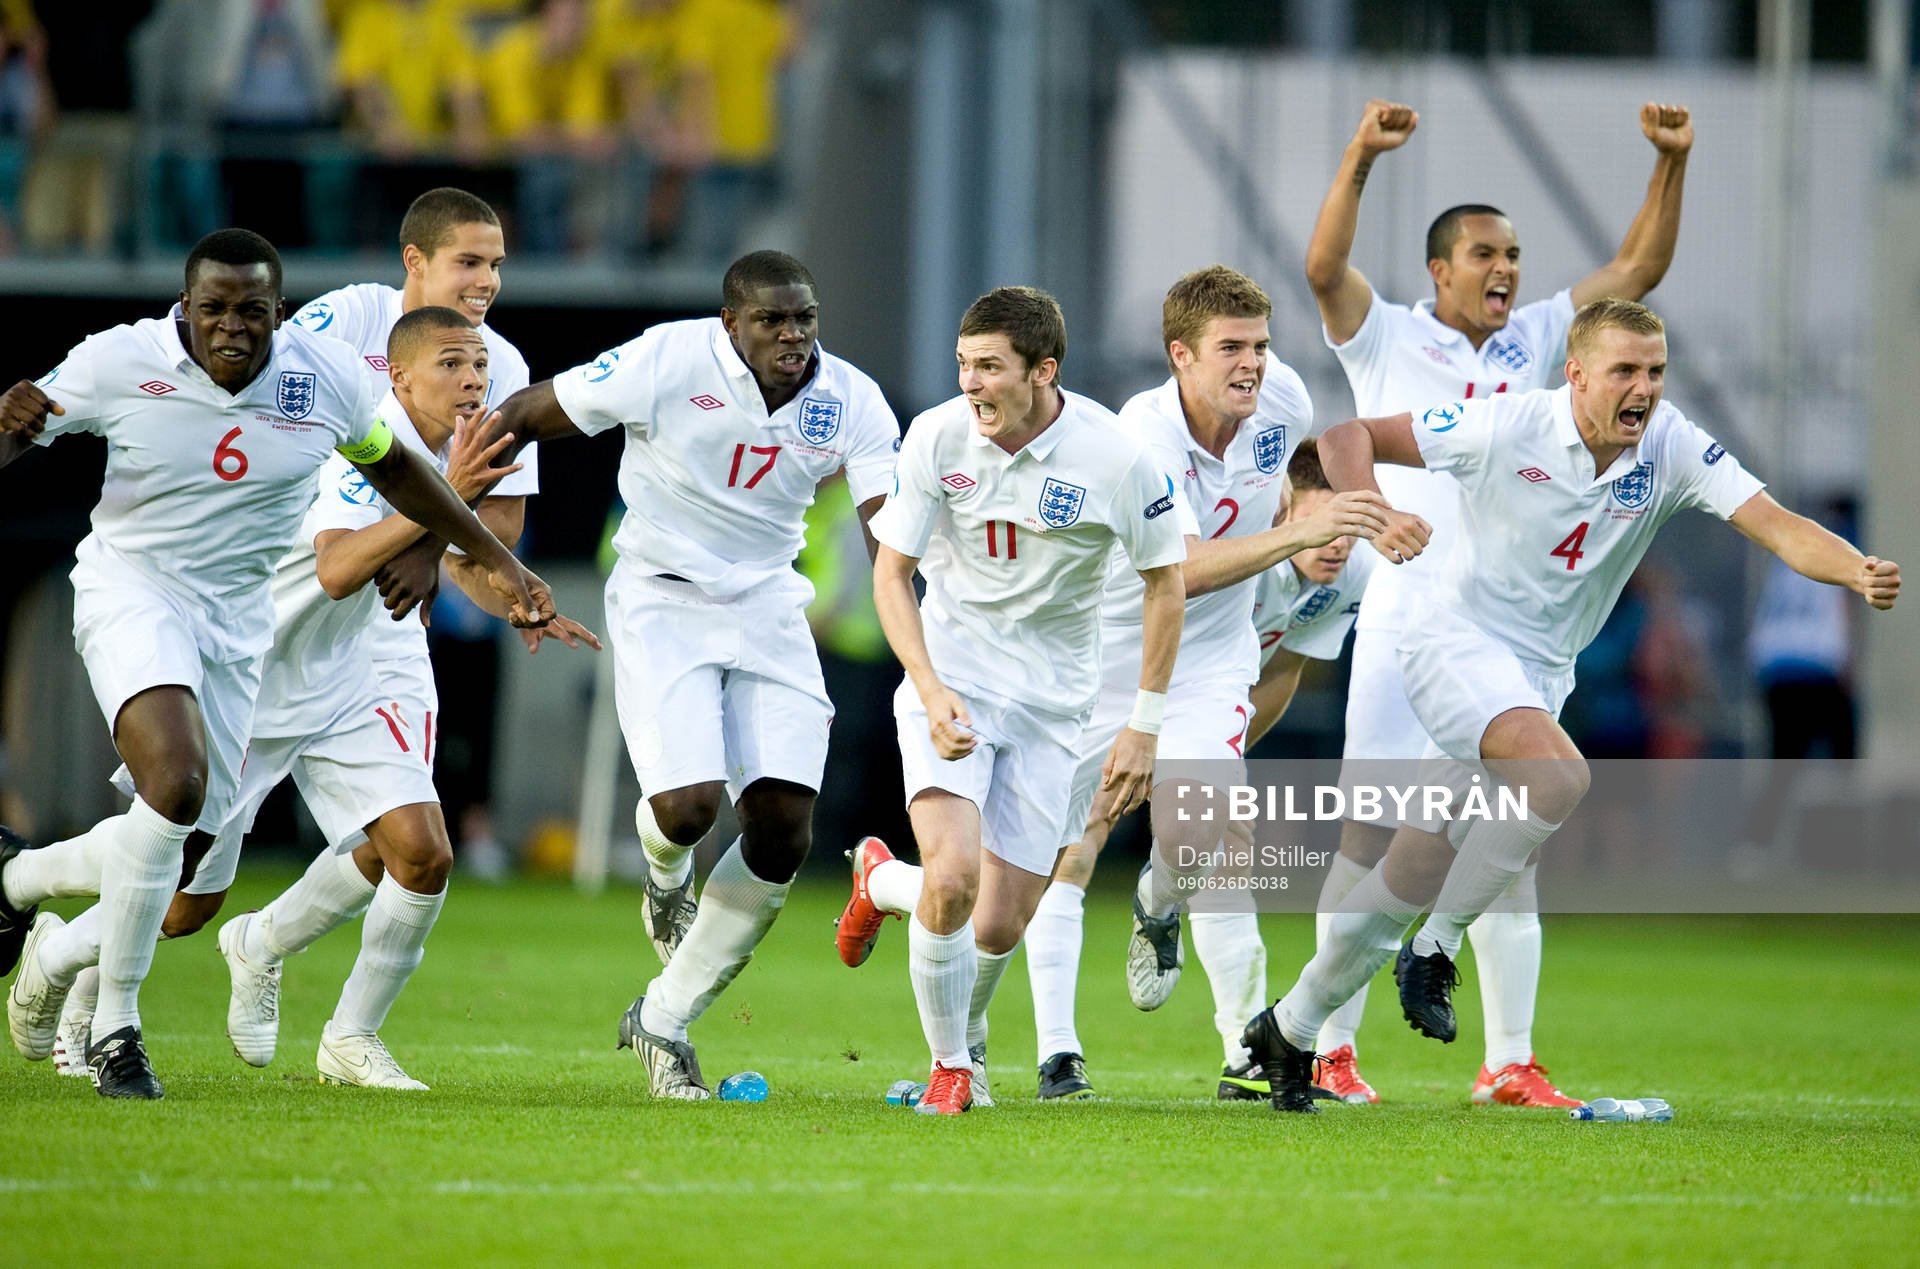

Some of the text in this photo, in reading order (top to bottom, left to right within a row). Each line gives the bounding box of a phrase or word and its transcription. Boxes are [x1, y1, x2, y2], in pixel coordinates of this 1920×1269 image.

[272, 424, 297, 432] SWEDEN
[213, 426, 249, 481] 6
[728, 443, 782, 490] 17
[986, 520, 1017, 560] 11
[1210, 497, 1239, 540] 2
[1550, 521, 1590, 571] 4
